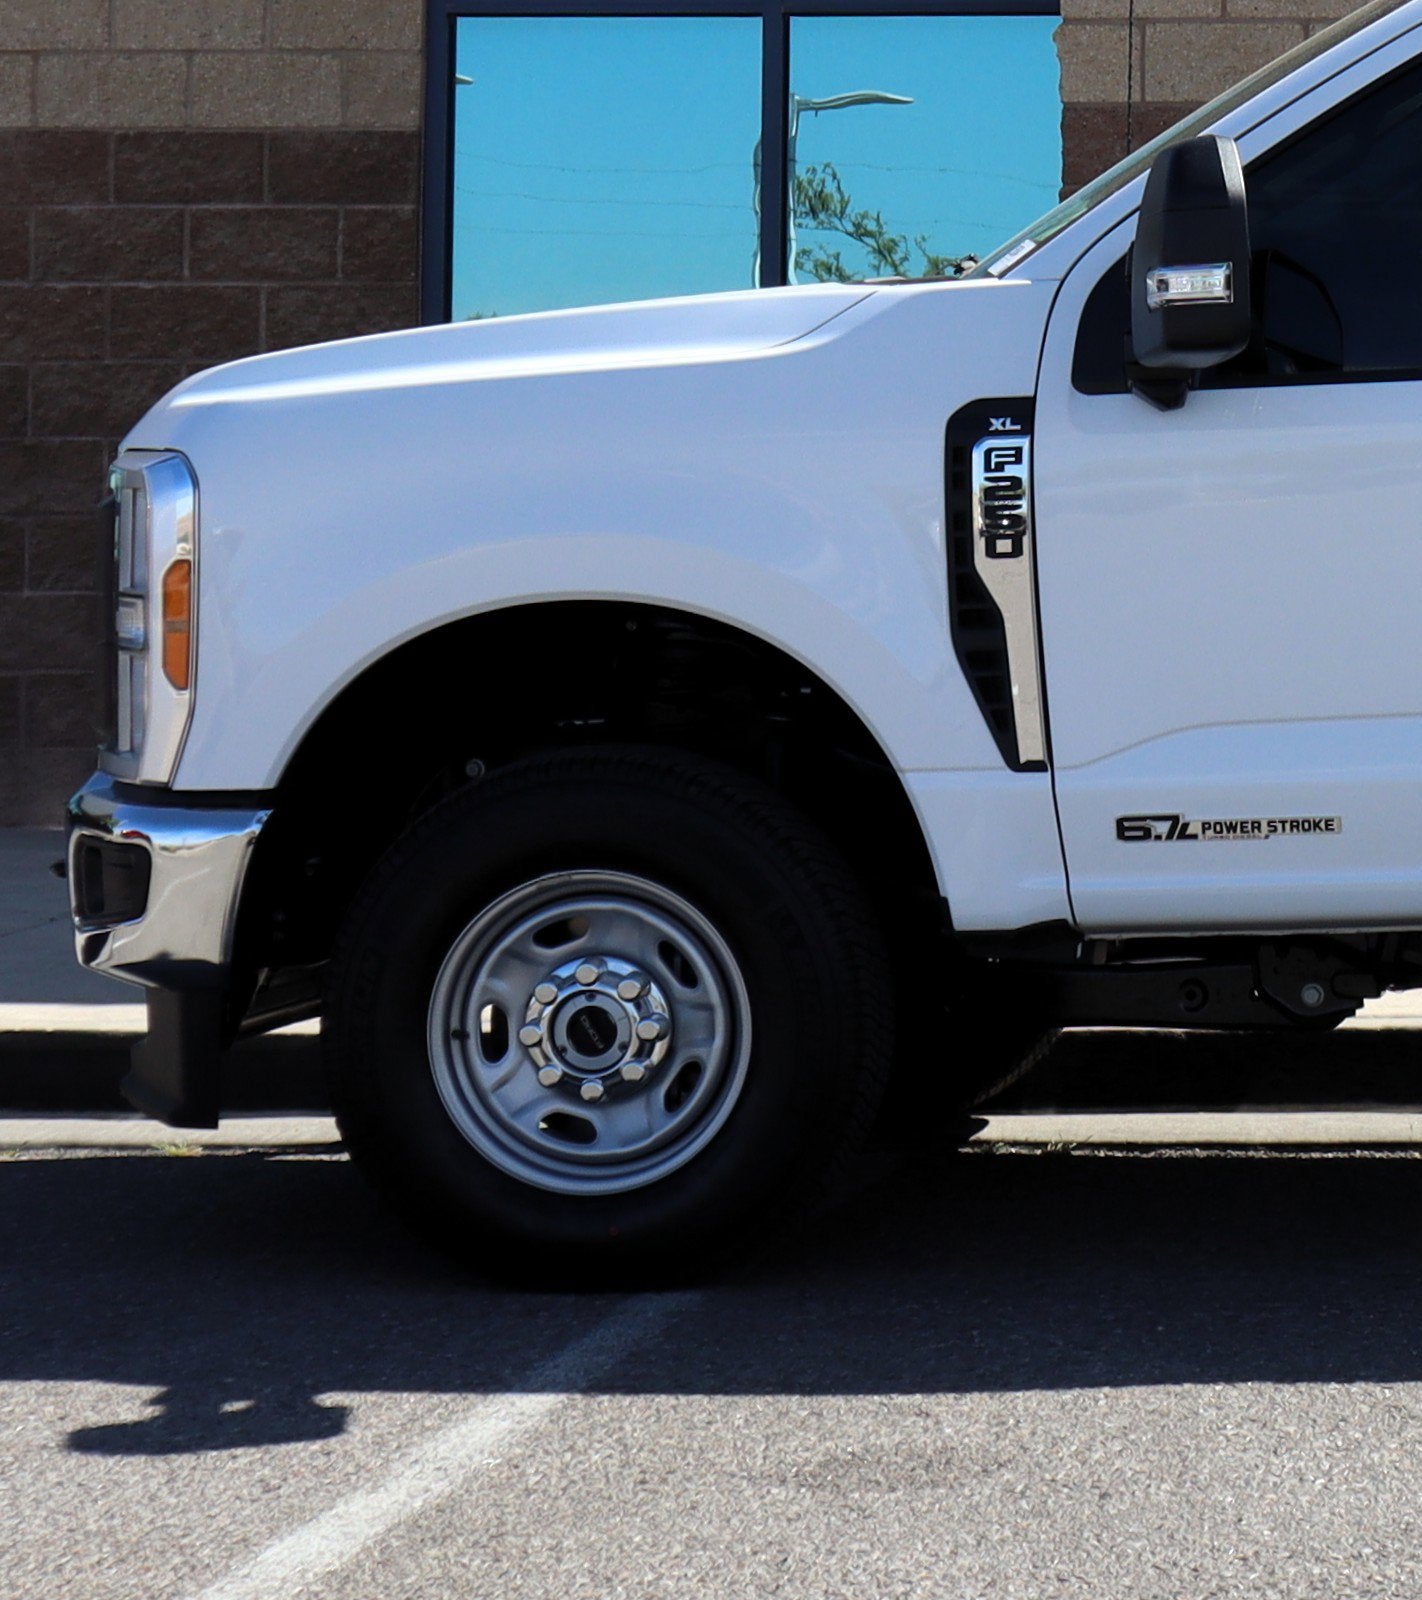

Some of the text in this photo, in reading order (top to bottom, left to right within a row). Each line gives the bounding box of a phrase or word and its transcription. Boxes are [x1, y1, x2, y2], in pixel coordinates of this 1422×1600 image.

[988, 417, 1022, 431] XL
[1116, 814, 1199, 841] 6.7L
[1201, 821, 1262, 835] POWER
[1266, 818, 1335, 834] STROKE
